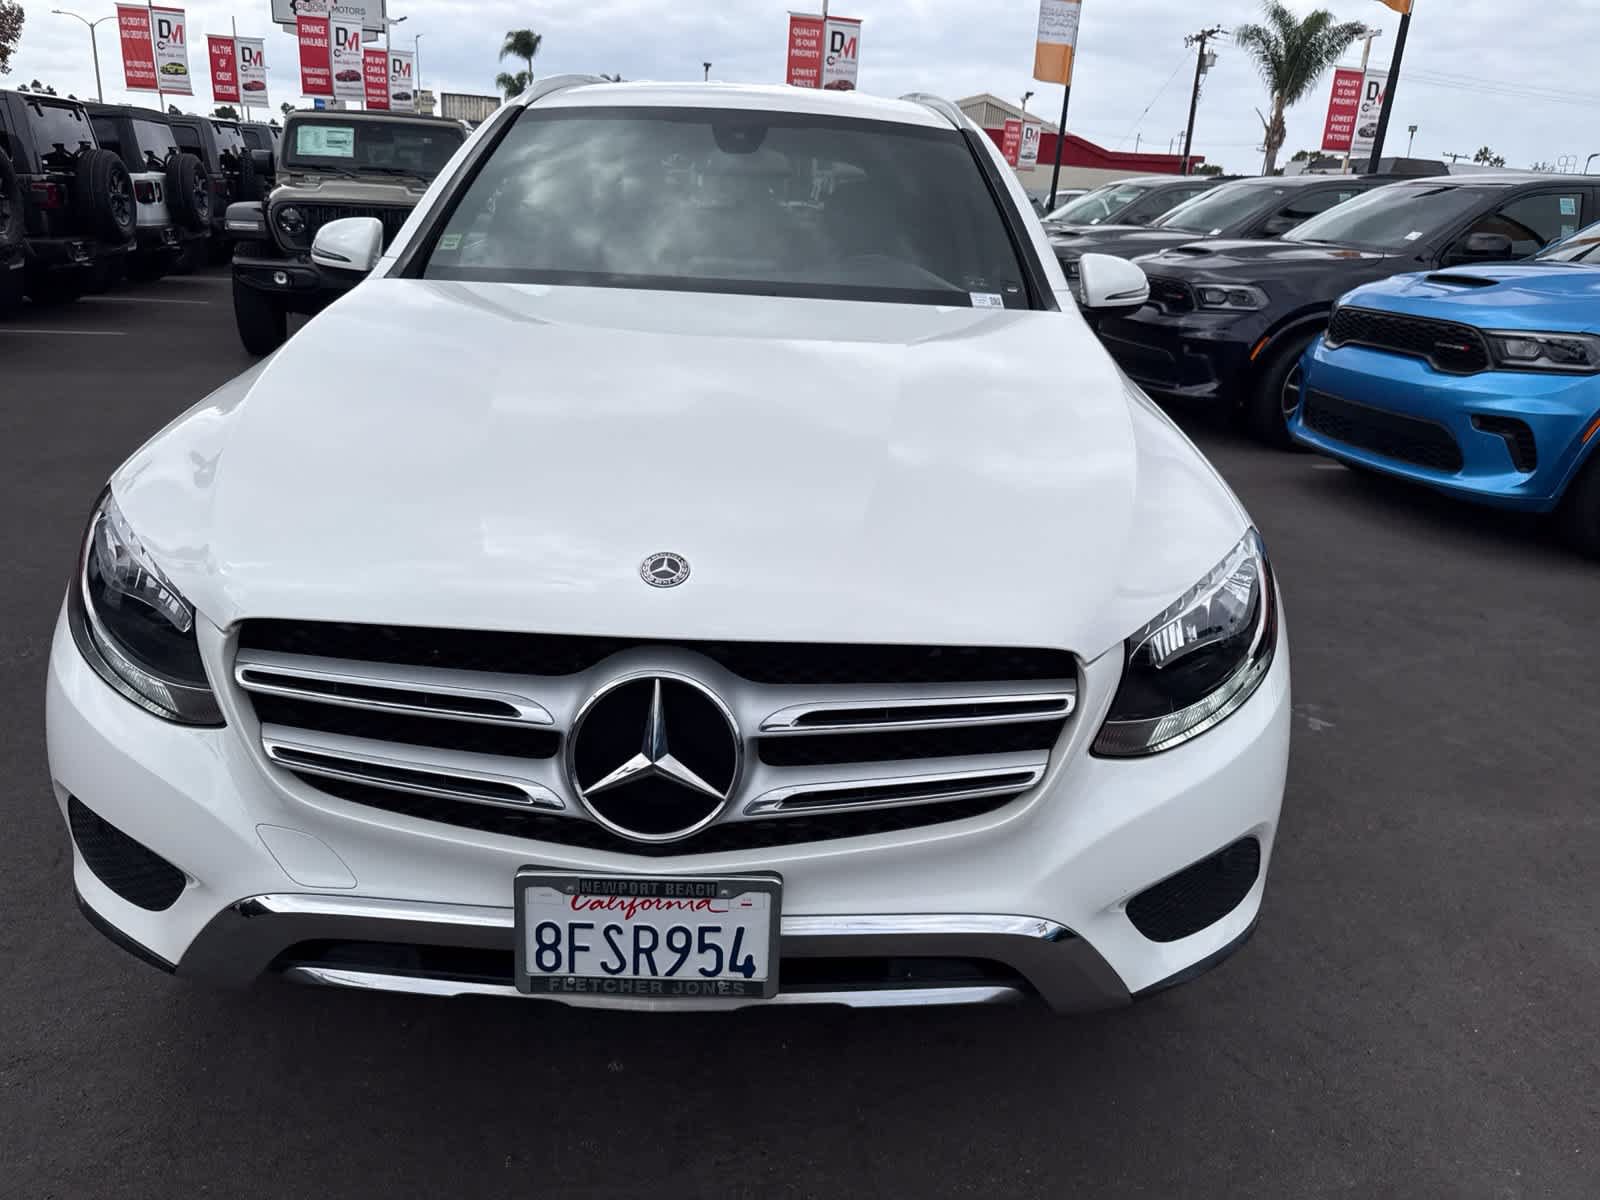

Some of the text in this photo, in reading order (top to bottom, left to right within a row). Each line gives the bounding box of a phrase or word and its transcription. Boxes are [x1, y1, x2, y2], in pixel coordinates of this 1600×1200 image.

[332, 6, 366, 15] MOTORS
[301, 24, 325, 34] FINANCE
[792, 27, 820, 37] QUALITY
[301, 37, 328, 47] AVAILABLE
[802, 39, 816, 47] OUR
[212, 45, 232, 55] ALL TYPE
[791, 49, 819, 58] PRIORITY
[219, 58, 226, 67] OF
[375, 56, 386, 65] BUY
[216, 71, 232, 80] CREDIT
[792, 68, 817, 77] LOWEST
[1332, 98, 1358, 106] PRIORITY
[581, 880, 716, 896] NEWPORT BEACH
[571, 895, 728, 920] California
[535, 920, 756, 978] 8FSR954
[550, 978, 745, 996] FLETCHER JONES
